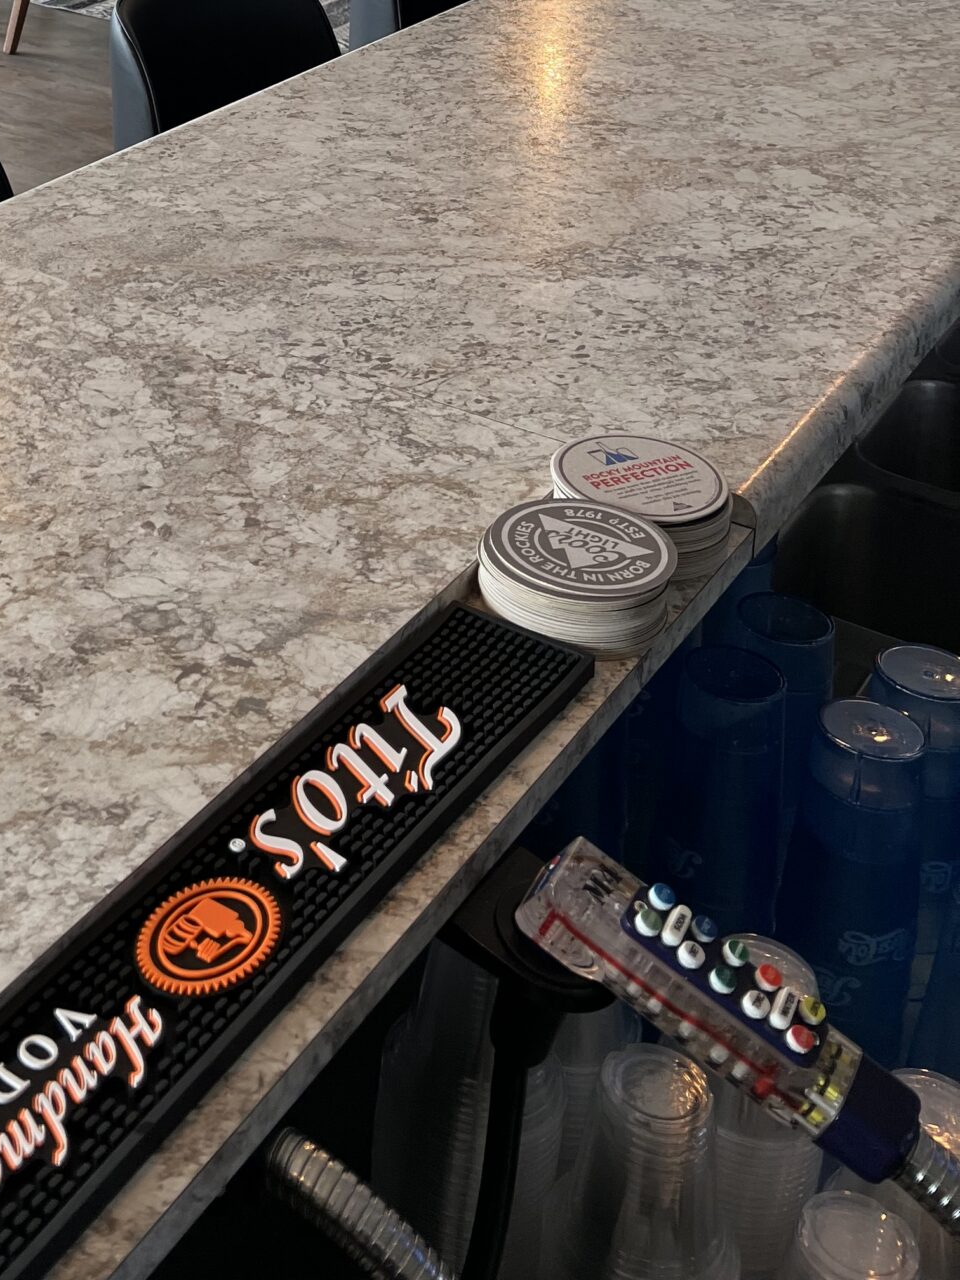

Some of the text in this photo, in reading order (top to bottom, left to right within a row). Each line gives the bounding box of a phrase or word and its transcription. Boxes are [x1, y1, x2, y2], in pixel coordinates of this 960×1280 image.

[582, 467, 621, 482] ROCKY
[622, 455, 683, 474] MOUNTAIN
[590, 460, 693, 490] PERFECTION
[564, 508, 603, 520] 1978
[514, 520, 651, 583] BORN IN THE ROCKIES
[545, 530, 627, 564] Coors
[565, 526, 620, 550] LIGHT
[674, 913, 687, 932] SODA
